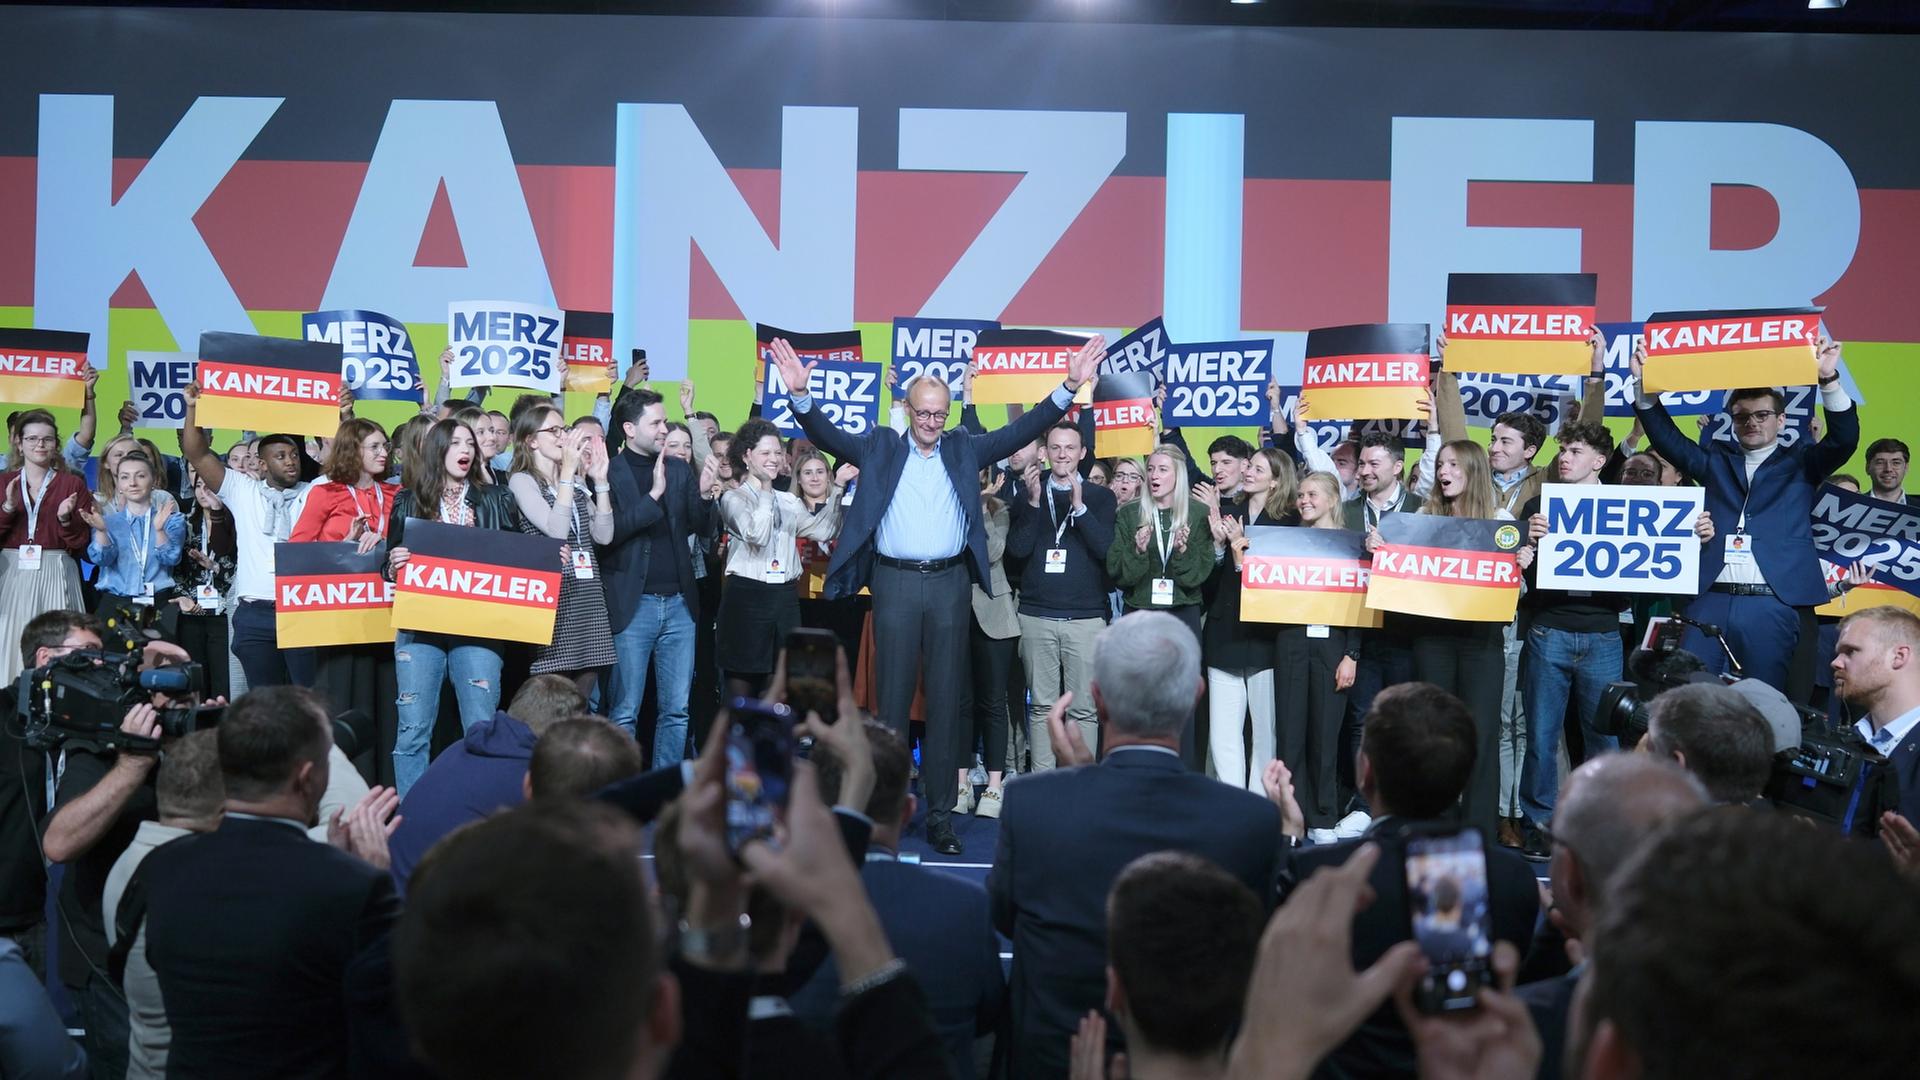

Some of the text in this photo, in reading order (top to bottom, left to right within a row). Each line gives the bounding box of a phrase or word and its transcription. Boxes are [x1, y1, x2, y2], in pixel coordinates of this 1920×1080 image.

[33, 94, 1861, 406] KANZLER
[307, 321, 413, 358] MERZ
[454, 311, 559, 348] MERZ
[1451, 312, 1590, 336] KANZLER.
[1650, 319, 1814, 350] KANZLER.
[564, 343, 609, 362] LER.
[896, 327, 982, 359] MER
[0, 354, 83, 376] NZLER.
[133, 360, 198, 389] ME
[342, 357, 413, 391] 025
[460, 345, 551, 380] 2025
[901, 361, 968, 391] 202
[978, 352, 1079, 370] KANZLE
[1167, 350, 1267, 383] MERZ
[1307, 361, 1426, 385] KANZLER.
[203, 369, 338, 401] KANZLER.
[1173, 385, 1260, 417] 2025
[141, 392, 187, 420] 20
[771, 399, 866, 434] 225
[1460, 386, 1559, 425] 2025
[1549, 497, 1696, 538] MERZ
[1811, 493, 1920, 543] MER
[1379, 550, 1519, 583] KANZLER.
[1554, 540, 1682, 580] 2025
[1811, 523, 1920, 580] 2025
[404, 563, 554, 604] KANZLER.
[1248, 563, 1370, 589] KANZLER
[282, 581, 395, 606] KANZLE
